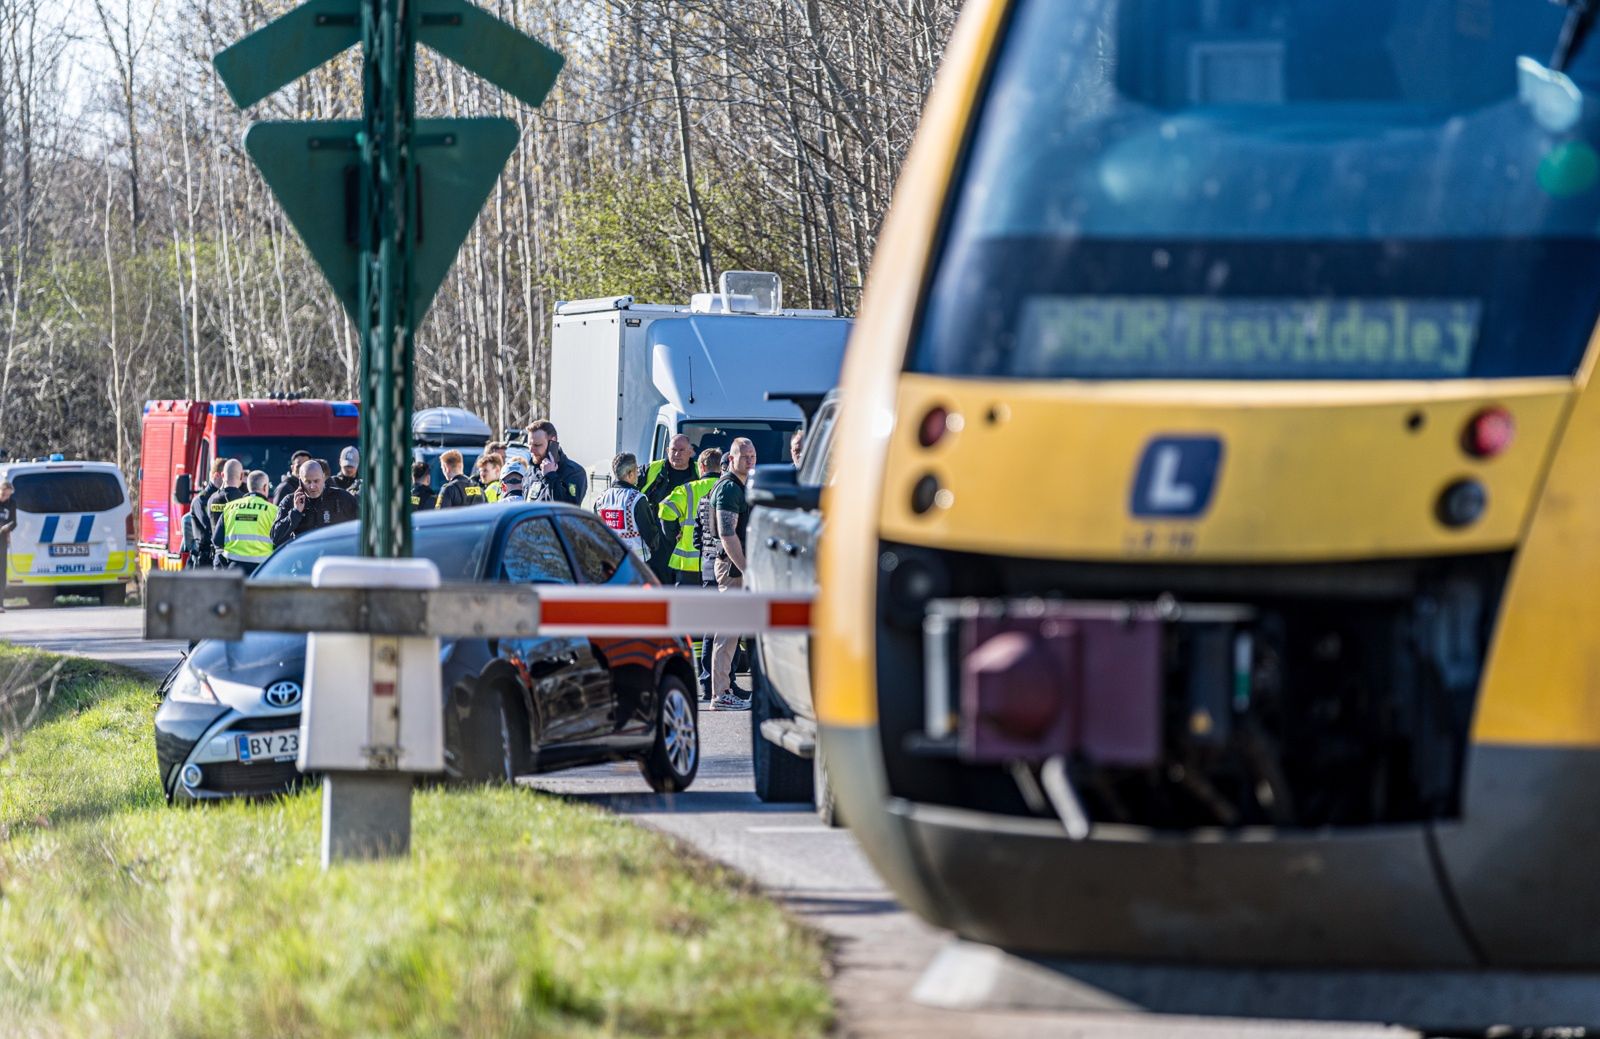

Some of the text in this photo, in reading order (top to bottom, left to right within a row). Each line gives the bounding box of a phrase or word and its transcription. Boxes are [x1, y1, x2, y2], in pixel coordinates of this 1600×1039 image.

[1147, 445, 1196, 509] L
[231, 502, 268, 511] POLITI
[605, 511, 619, 519] CHEF
[56, 564, 85, 573] POLITI
[250, 734, 299, 755] BY 23
